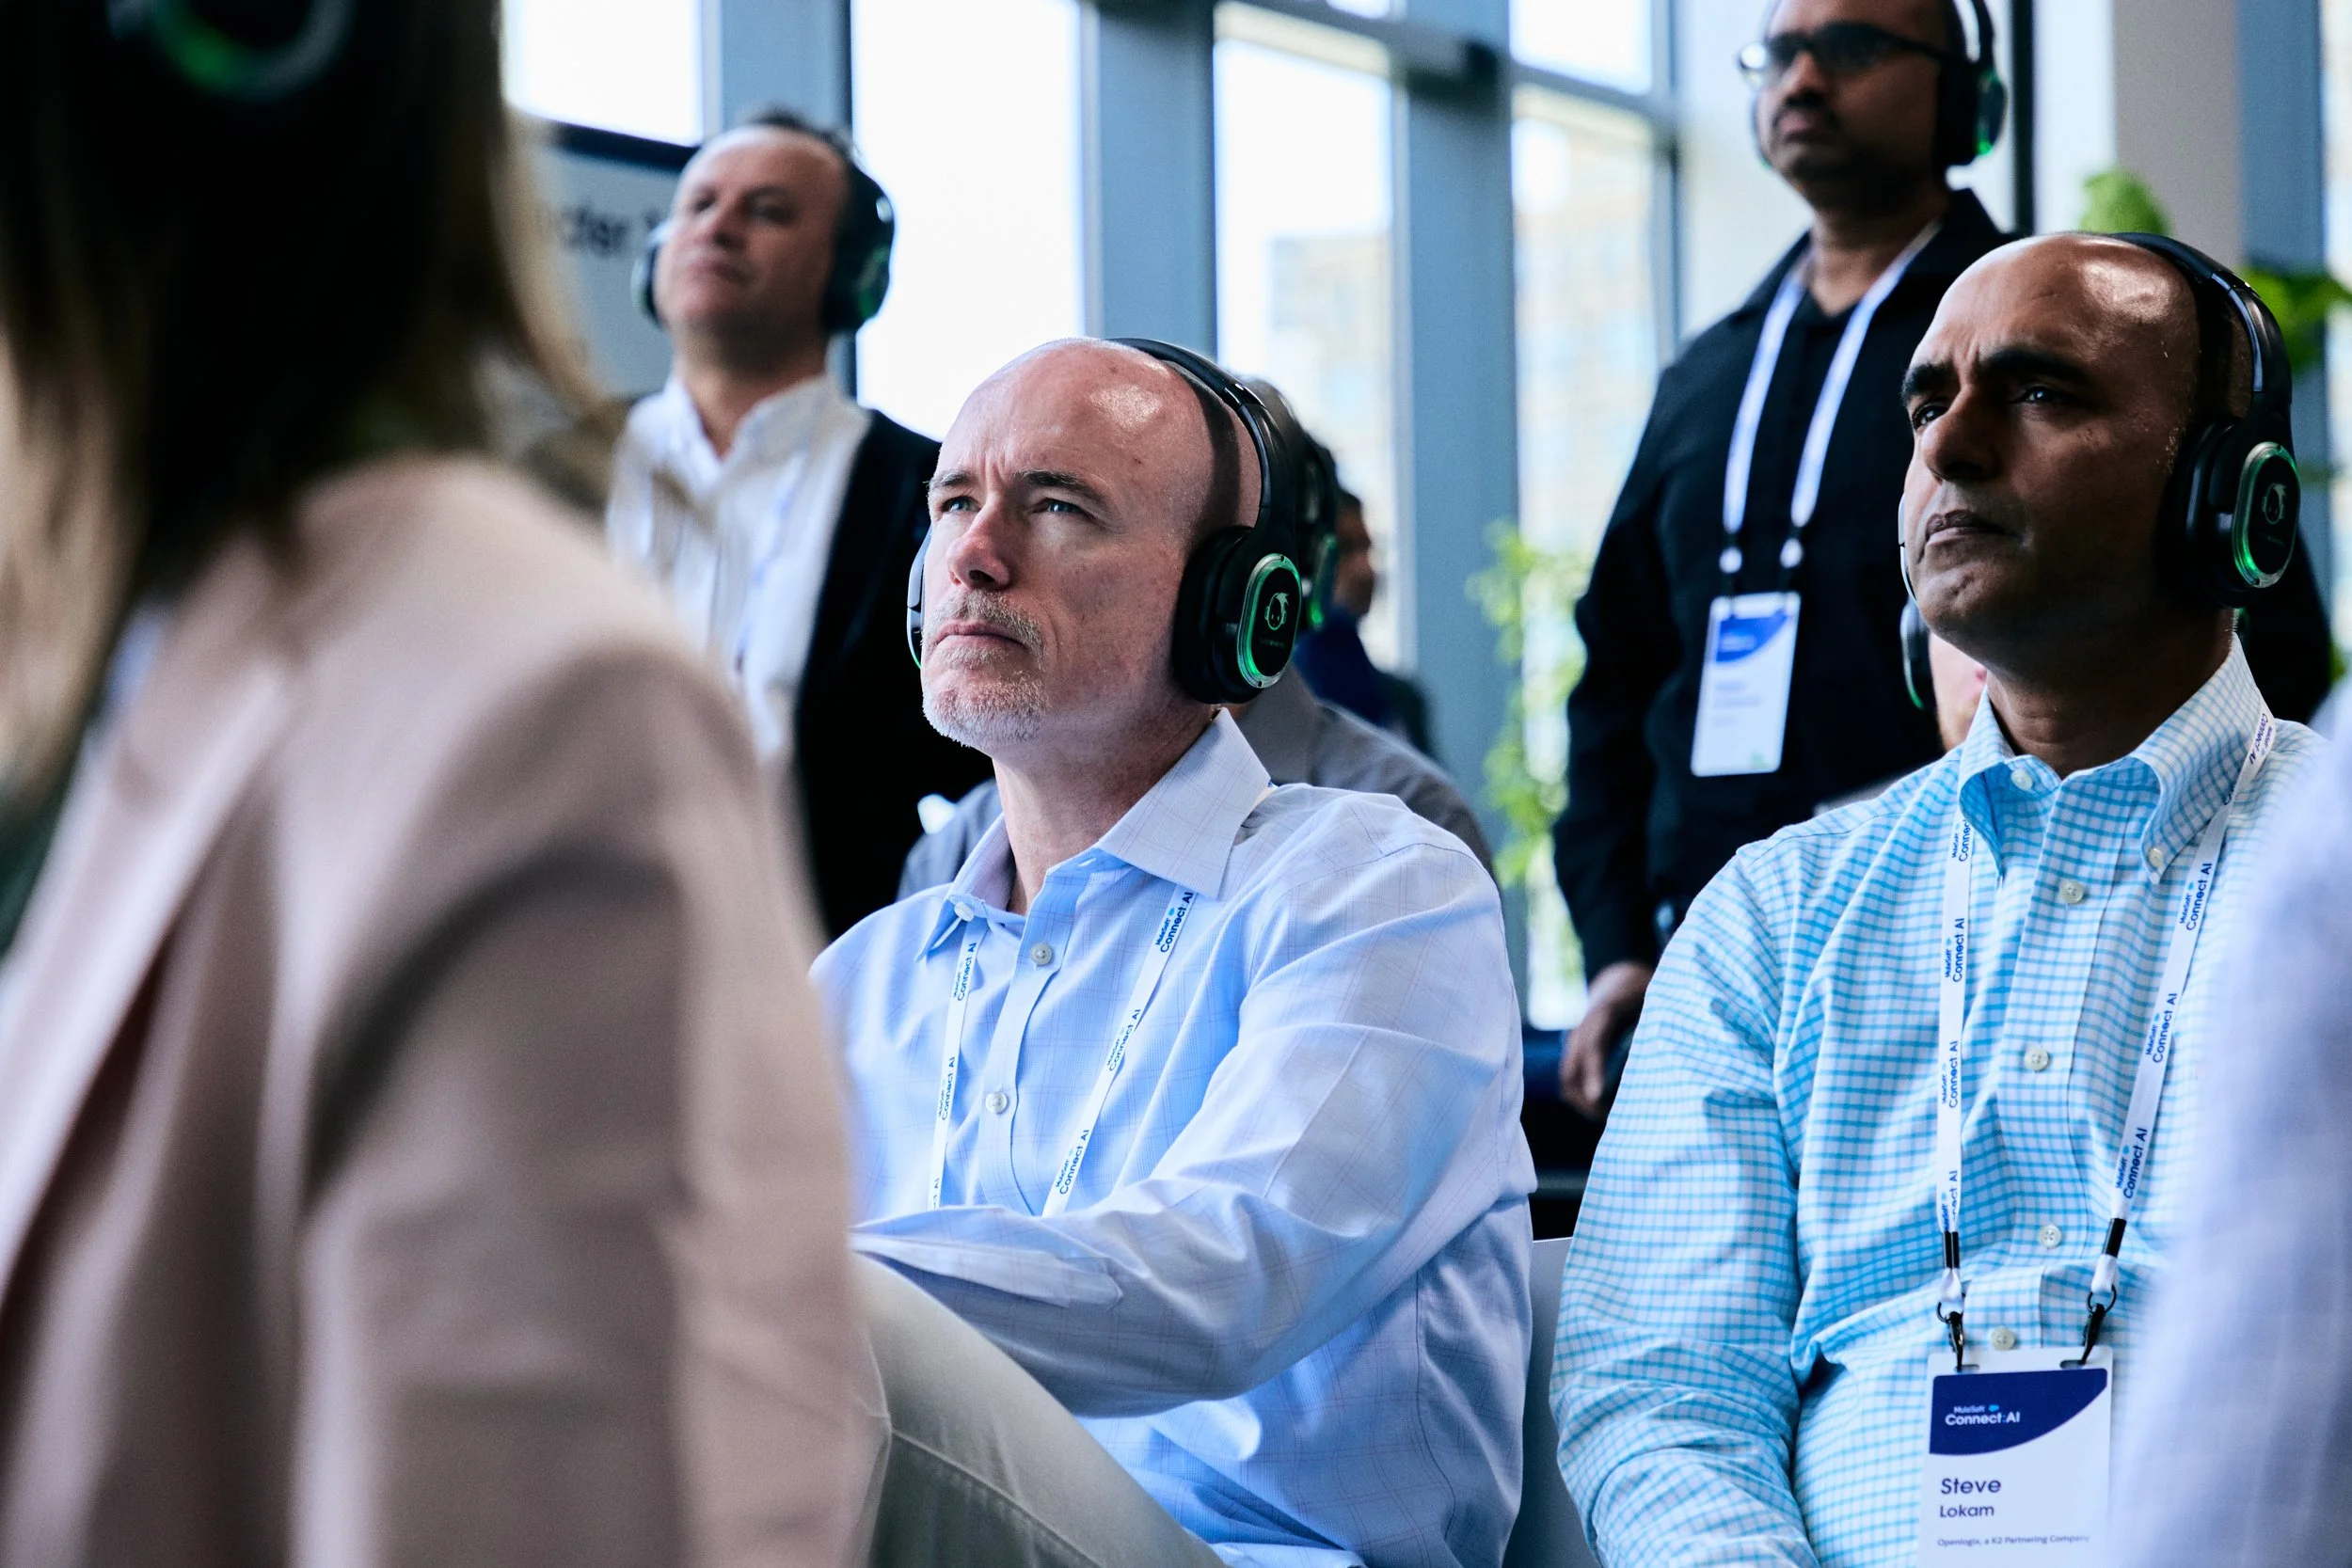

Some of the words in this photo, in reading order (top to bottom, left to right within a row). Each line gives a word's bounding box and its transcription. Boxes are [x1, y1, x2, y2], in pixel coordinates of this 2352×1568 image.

[1160, 907, 1186, 953] Connect
[1182, 891, 1194, 904] AI
[1954, 917, 1965, 929] AI
[2185, 879, 2208, 931] Connect
[2201, 863, 2213, 875] AI
[958, 956, 972, 1001] Connect
[967, 942, 977, 953] AI
[1952, 933, 1964, 983] Connect
[1109, 1024, 1134, 1071] Connect
[1132, 1008, 1141, 1020] AI
[1949, 1040, 1959, 1053] AI
[2153, 1009, 2173, 1063] Connect
[2166, 992, 2178, 1006] AI
[1948, 1057, 1959, 1108] Connect
[1059, 1145, 1084, 1195] Connect
[1080, 1129, 1089, 1141] AI
[2122, 1145, 2144, 1199] Connect
[2135, 1127, 2148, 1143] AI
[1939, 1504, 1994, 1518] Lokam
[1940, 1478, 2002, 1495] Steve
[1991, 1536, 2002, 1544] K2
[2004, 1535, 2047, 1544] Partnering
[2049, 1534, 2090, 1544] Company
